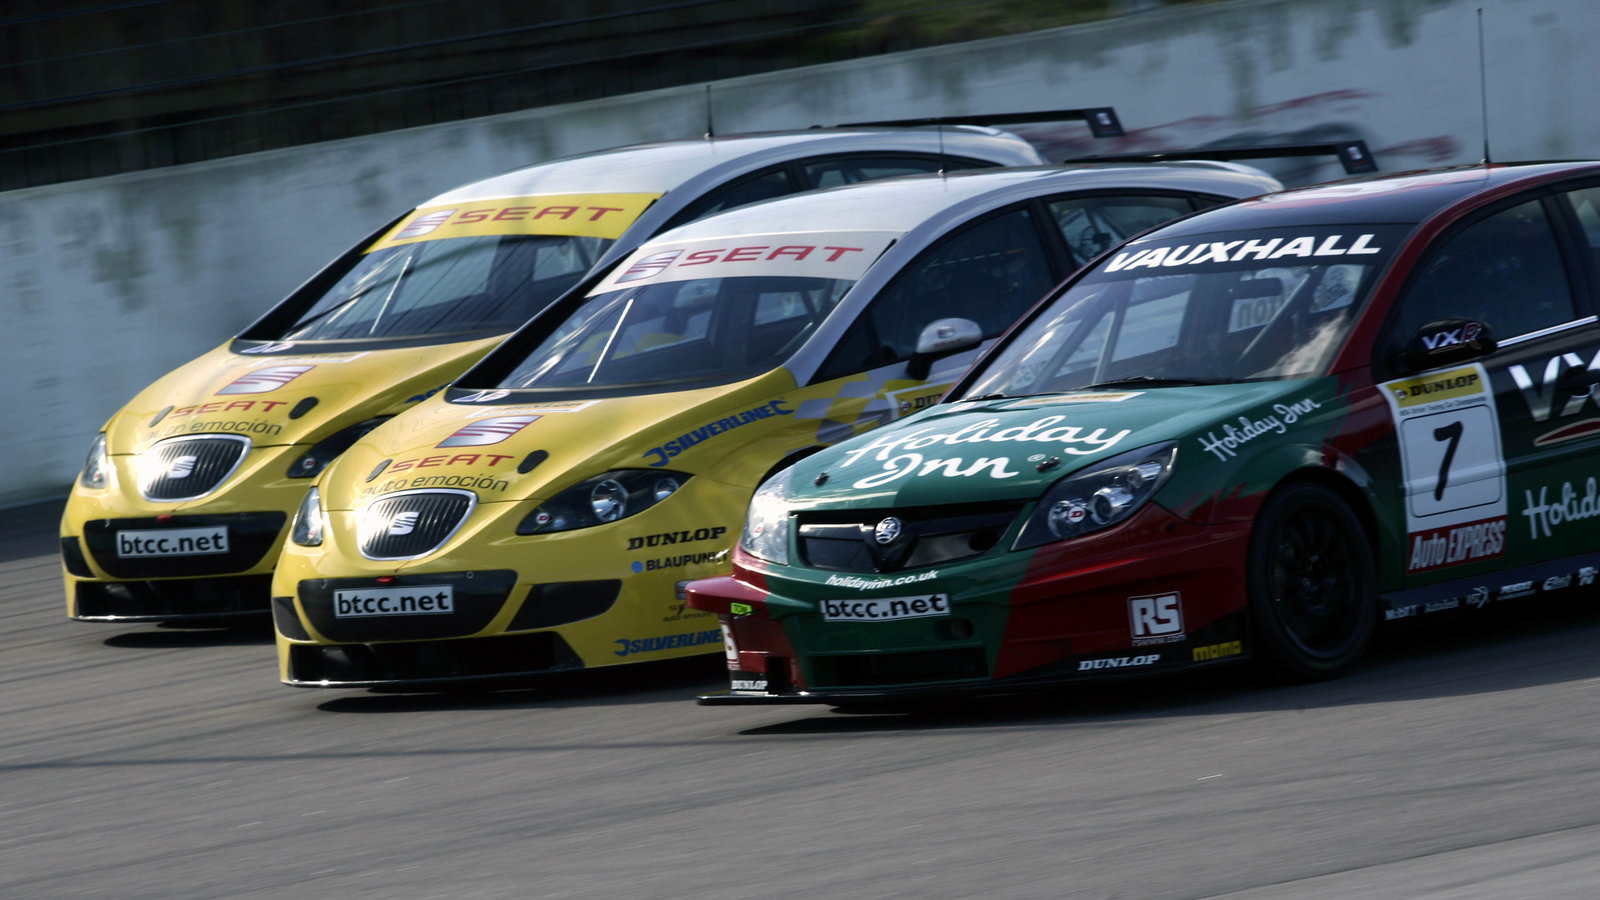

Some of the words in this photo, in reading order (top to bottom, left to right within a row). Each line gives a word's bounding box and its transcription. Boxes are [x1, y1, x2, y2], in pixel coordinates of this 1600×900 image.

[452, 206, 624, 224] SEAT
[678, 245, 863, 268] SEAT
[1104, 234, 1381, 273] VAUXHALL
[1422, 322, 1482, 350] VXR
[1410, 373, 1478, 397] DUNLOP
[169, 400, 288, 419] SEAT
[191, 418, 283, 436] emoción
[1197, 416, 1286, 461] Holiday
[1273, 398, 1321, 424] Inn
[840, 415, 1131, 468] Holiday
[387, 453, 515, 474] SEAT
[852, 453, 1019, 489] Inn
[1433, 421, 1464, 502] 7
[363, 478, 407, 497] auto
[409, 473, 509, 492] emoción
[1522, 476, 1600, 539] Holid
[120, 531, 225, 555] btcc.net
[627, 526, 727, 550] DUNLOP
[1408, 532, 1447, 570] Auto
[1445, 519, 1505, 563] EXPRESS
[825, 569, 940, 591] holidayinn.co.uk
[338, 590, 449, 615] btcc.net
[825, 594, 945, 618] btcc.net
[1131, 595, 1182, 636] RS
[1078, 654, 1161, 671] DUNLOP
